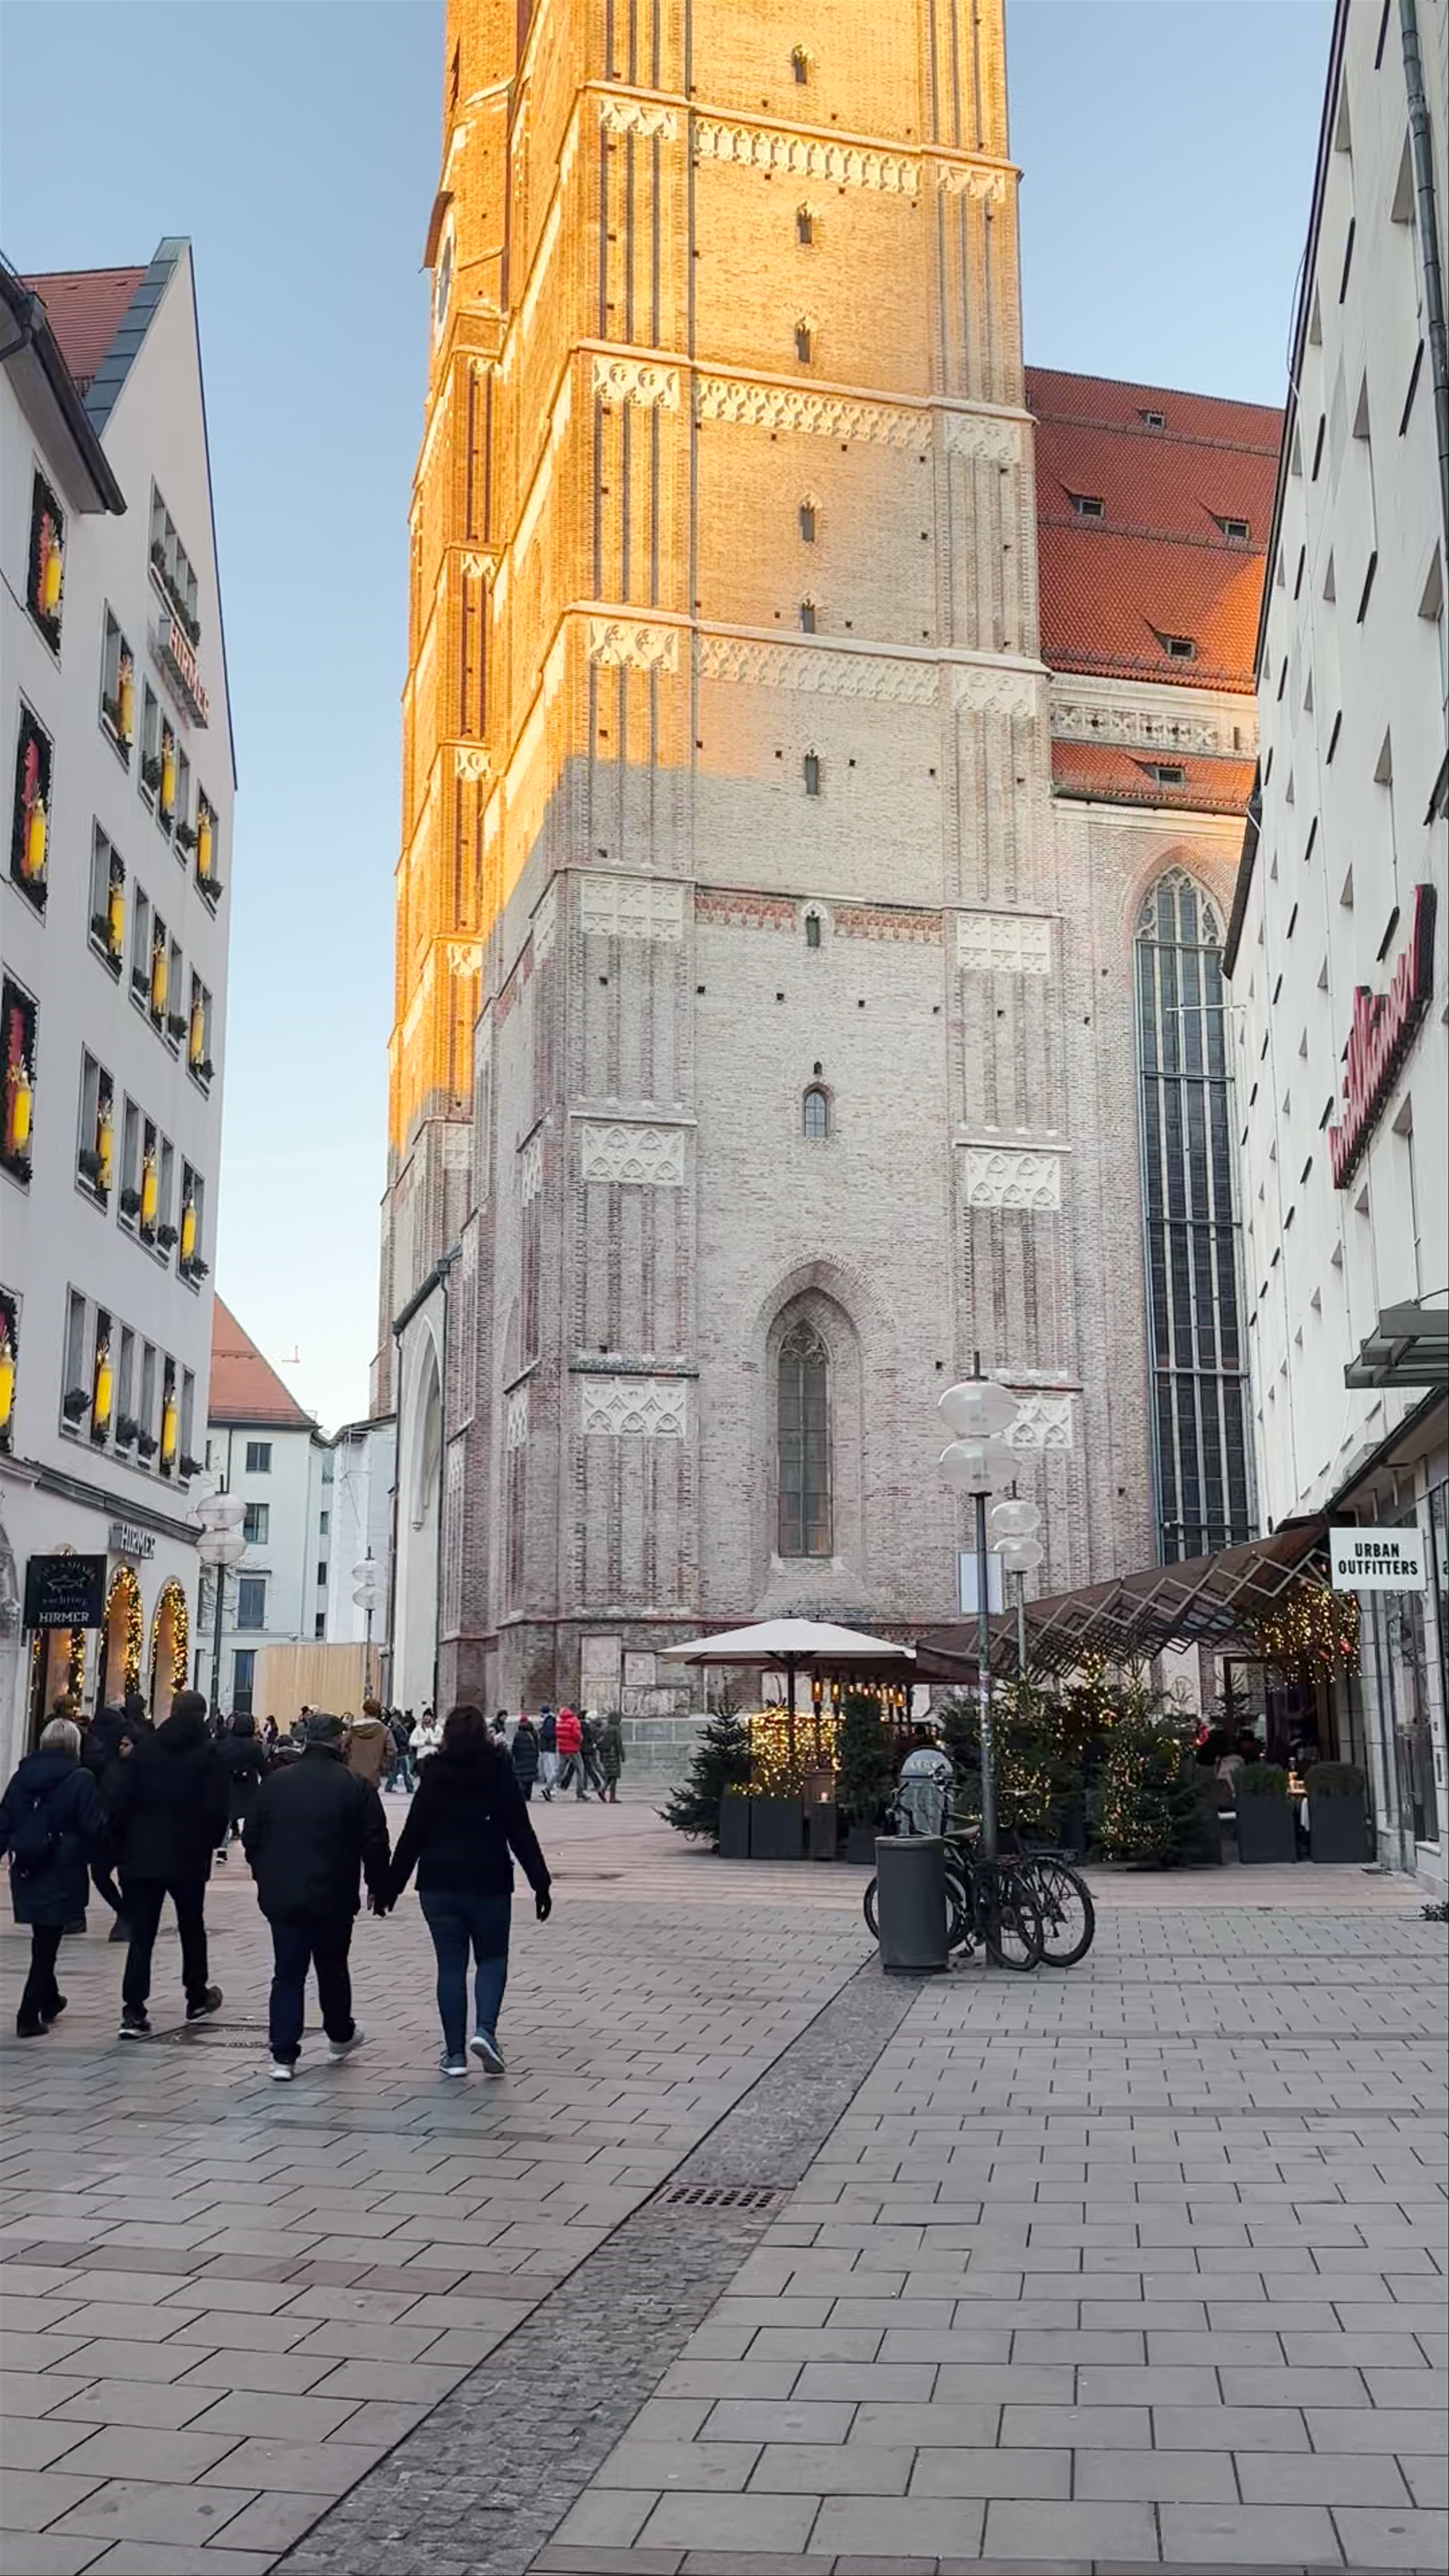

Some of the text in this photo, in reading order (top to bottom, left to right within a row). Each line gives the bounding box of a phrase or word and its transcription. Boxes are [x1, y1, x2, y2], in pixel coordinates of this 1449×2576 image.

[121, 1523, 155, 1558] HIRMER
[1354, 1543, 1400, 1558] URBAN
[1338, 1559, 1418, 1575] OUTFITTERS
[39, 1612, 90, 1622] HIRMER
